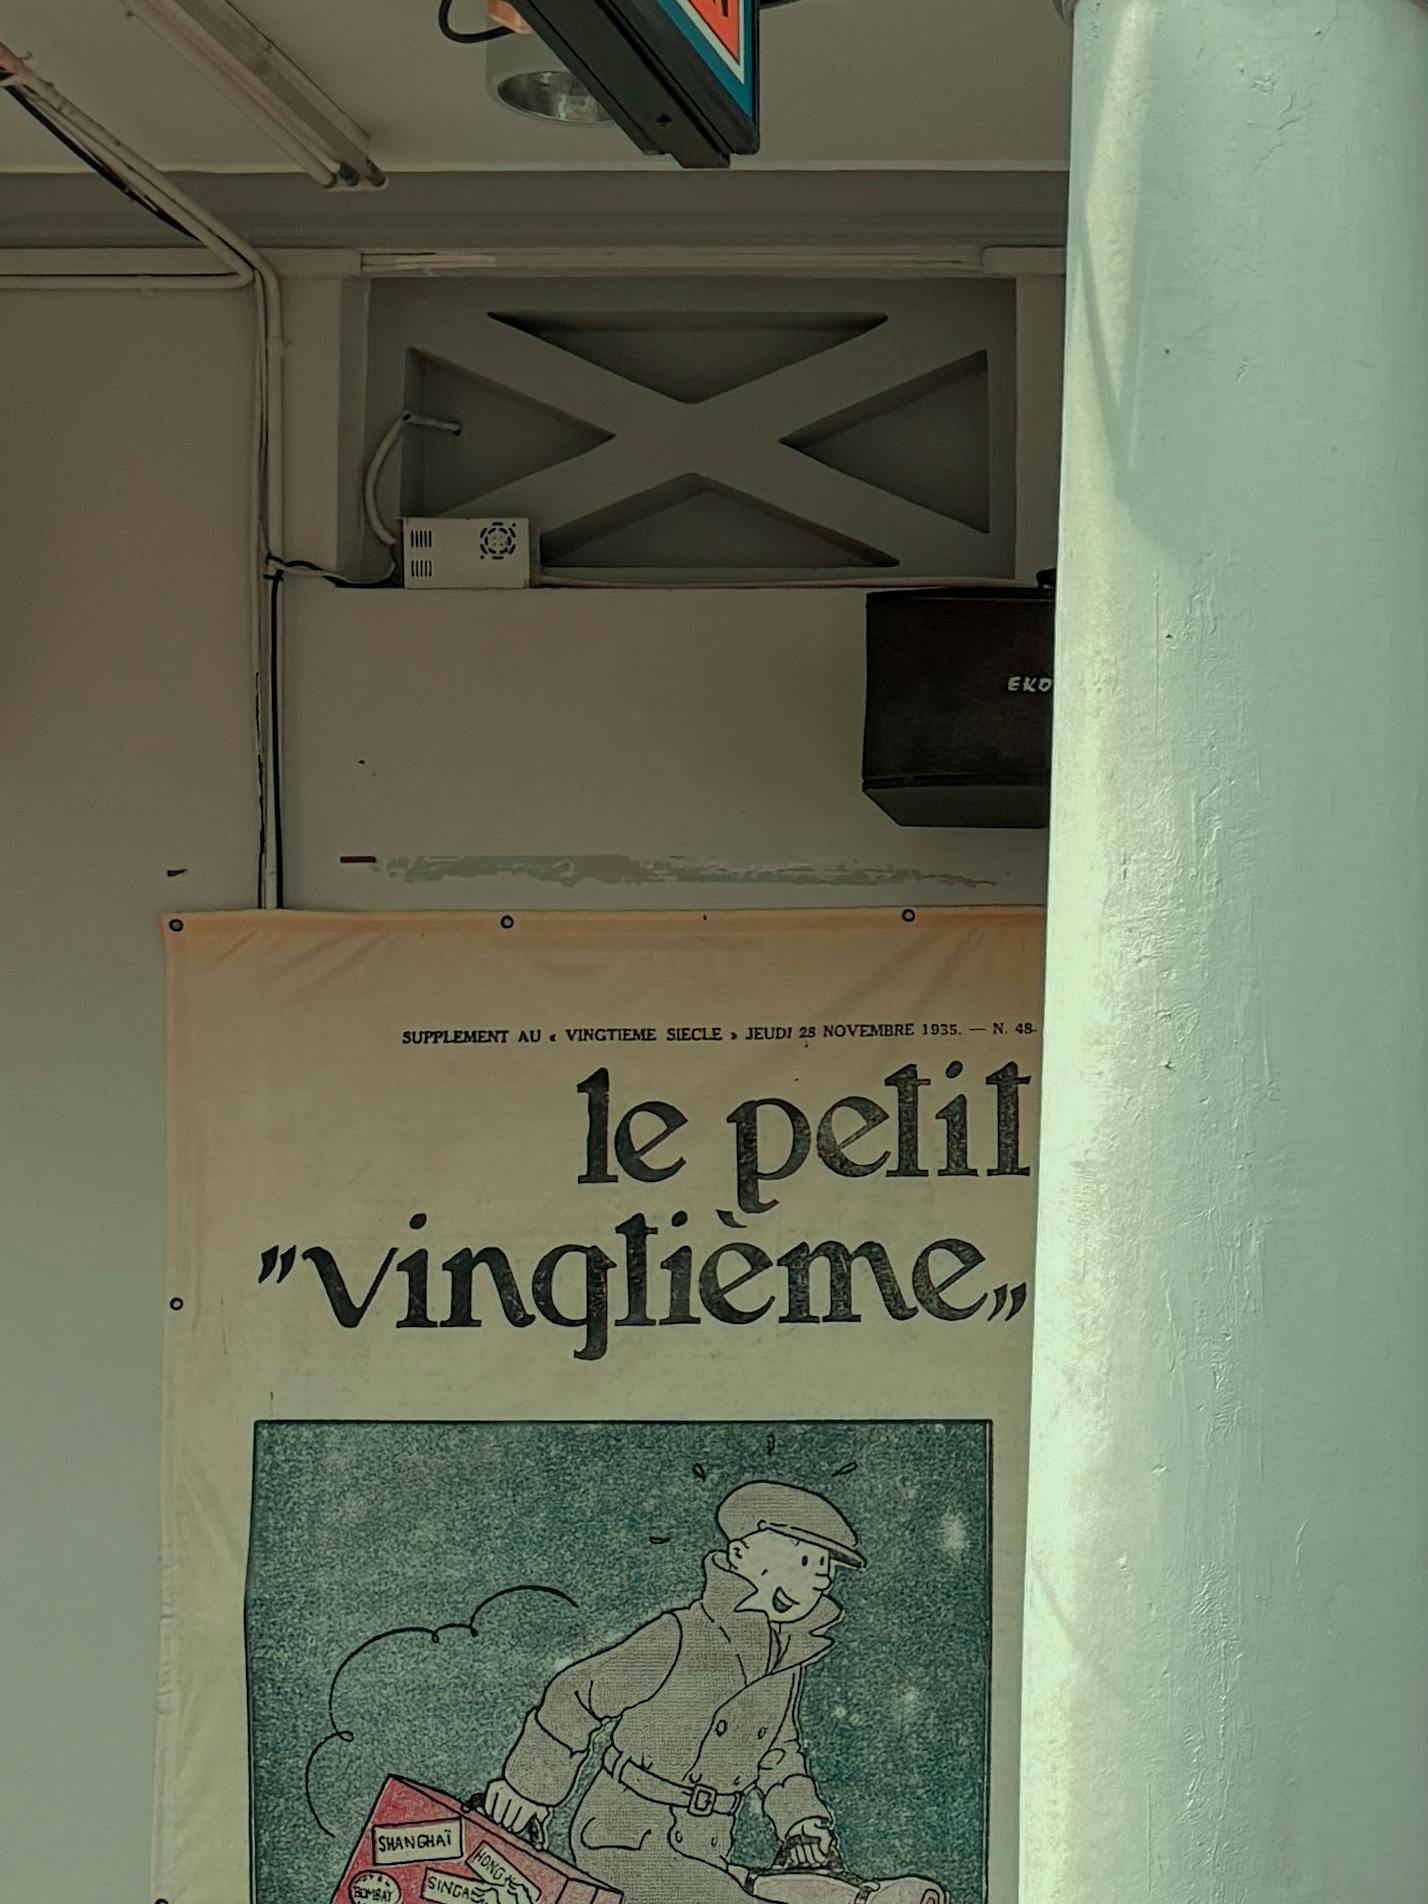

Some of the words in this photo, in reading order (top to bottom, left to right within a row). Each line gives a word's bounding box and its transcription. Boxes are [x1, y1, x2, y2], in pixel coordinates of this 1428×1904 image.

[401, 1029, 510, 1044] SUPPLEMENT
[518, 1029, 542, 1043] AU
[565, 1028, 657, 1042] VINGTIEME
[666, 1027, 723, 1041] SIECLE
[745, 1027, 793, 1041] JEUDI
[823, 1023, 915, 1037] NOVEMBRE
[921, 1022, 962, 1036] 1935.
[577, 1066, 689, 1184] le
[726, 1060, 1033, 1214] petit
[473, 1847, 506, 1881] HONG
